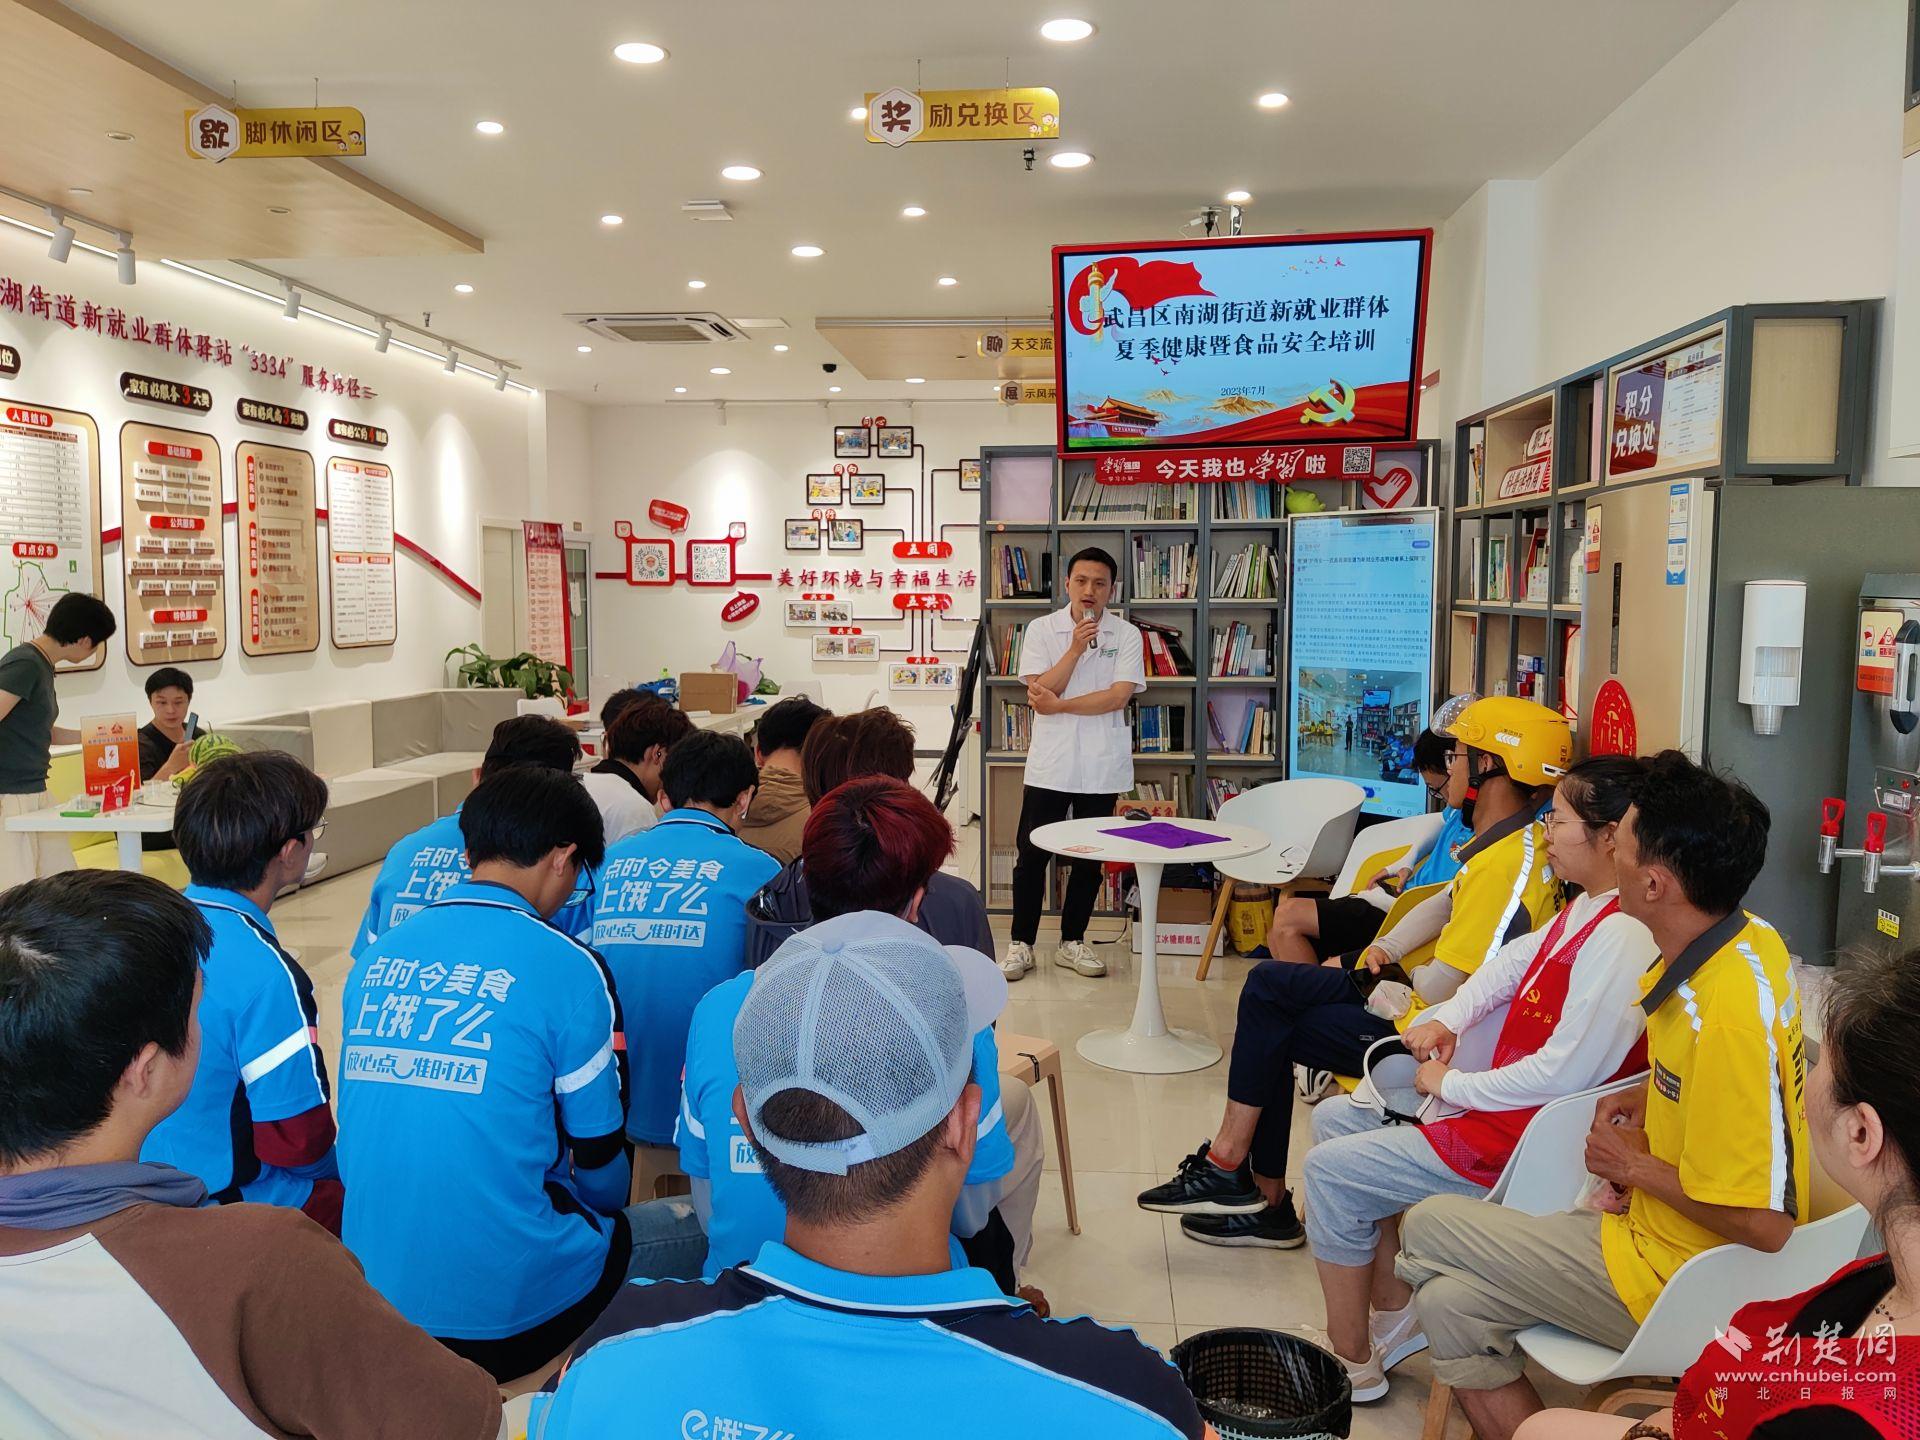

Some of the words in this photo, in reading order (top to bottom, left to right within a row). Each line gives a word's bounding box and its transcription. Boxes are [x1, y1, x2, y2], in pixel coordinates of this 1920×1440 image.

[881, 100, 1035, 133] 奖励兑换区
[199, 118, 342, 149] 歇脚休闲区
[1102, 294, 1390, 329] 武昌区南湖街道新就业群体
[1114, 328, 1376, 362] 夏季健康暨食品安全培训
[1220, 385, 1266, 397] 2023年7月
[1625, 385, 1653, 421] 积分
[1614, 420, 1656, 459] 兑换处
[18, 543, 54, 557] 网点分布
[777, 567, 977, 589] 美好环境与幸福生活
[396, 868, 472, 901] 上饿
[602, 857, 725, 882] 点时令美食
[595, 880, 709, 915] 上饿了么
[361, 955, 517, 1003] 点时令美食
[349, 992, 495, 1052] 上饿了么
